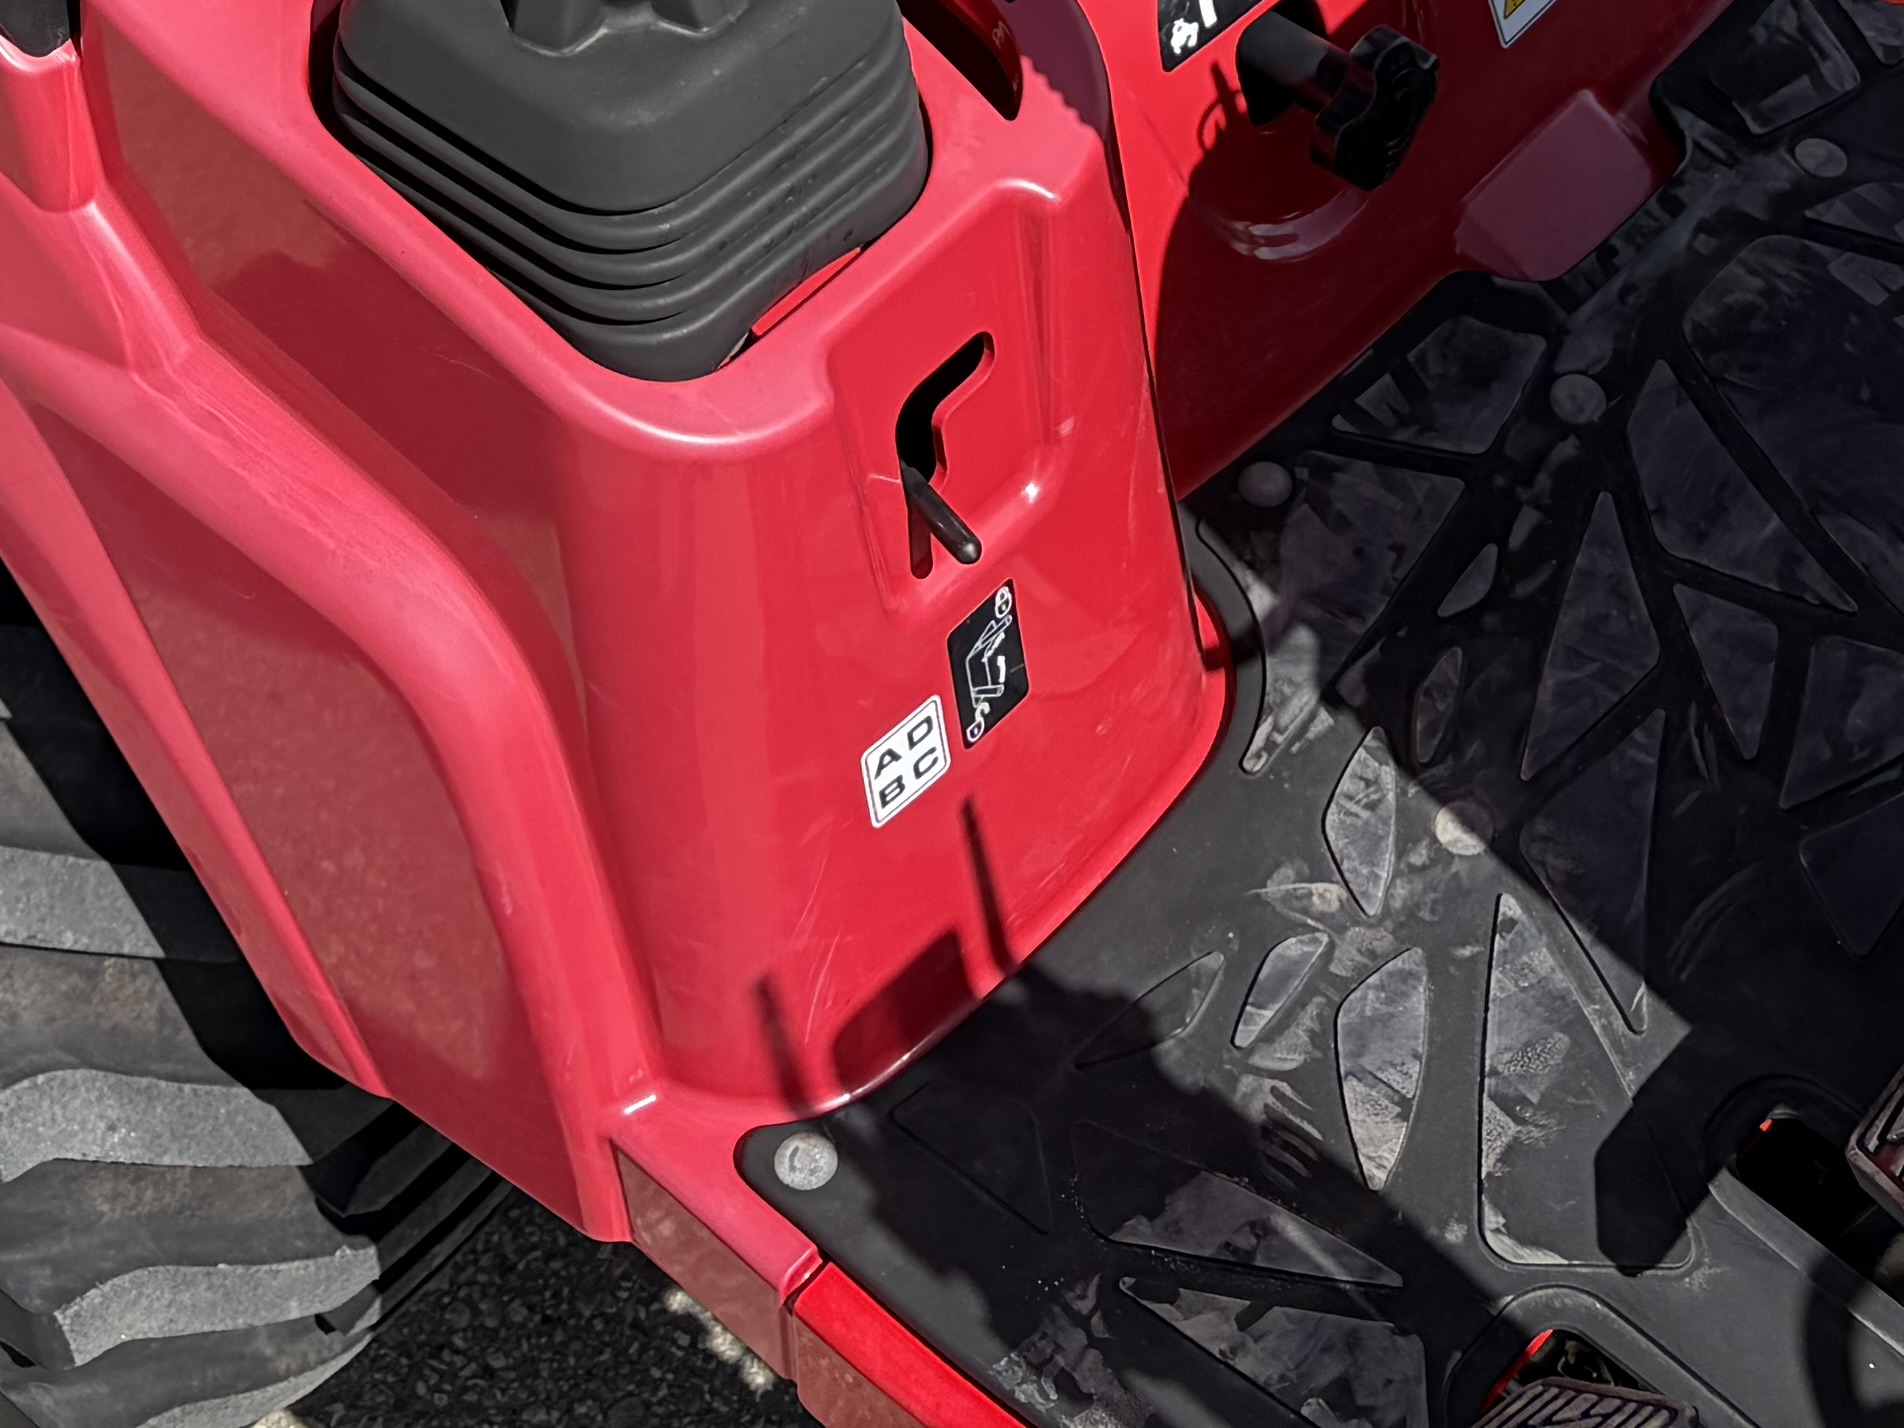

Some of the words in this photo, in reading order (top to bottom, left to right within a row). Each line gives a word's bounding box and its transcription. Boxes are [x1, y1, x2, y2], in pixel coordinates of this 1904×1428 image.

[873, 745, 902, 780] A
[906, 714, 934, 750] D
[879, 776, 906, 811] B
[912, 746, 940, 780] C
